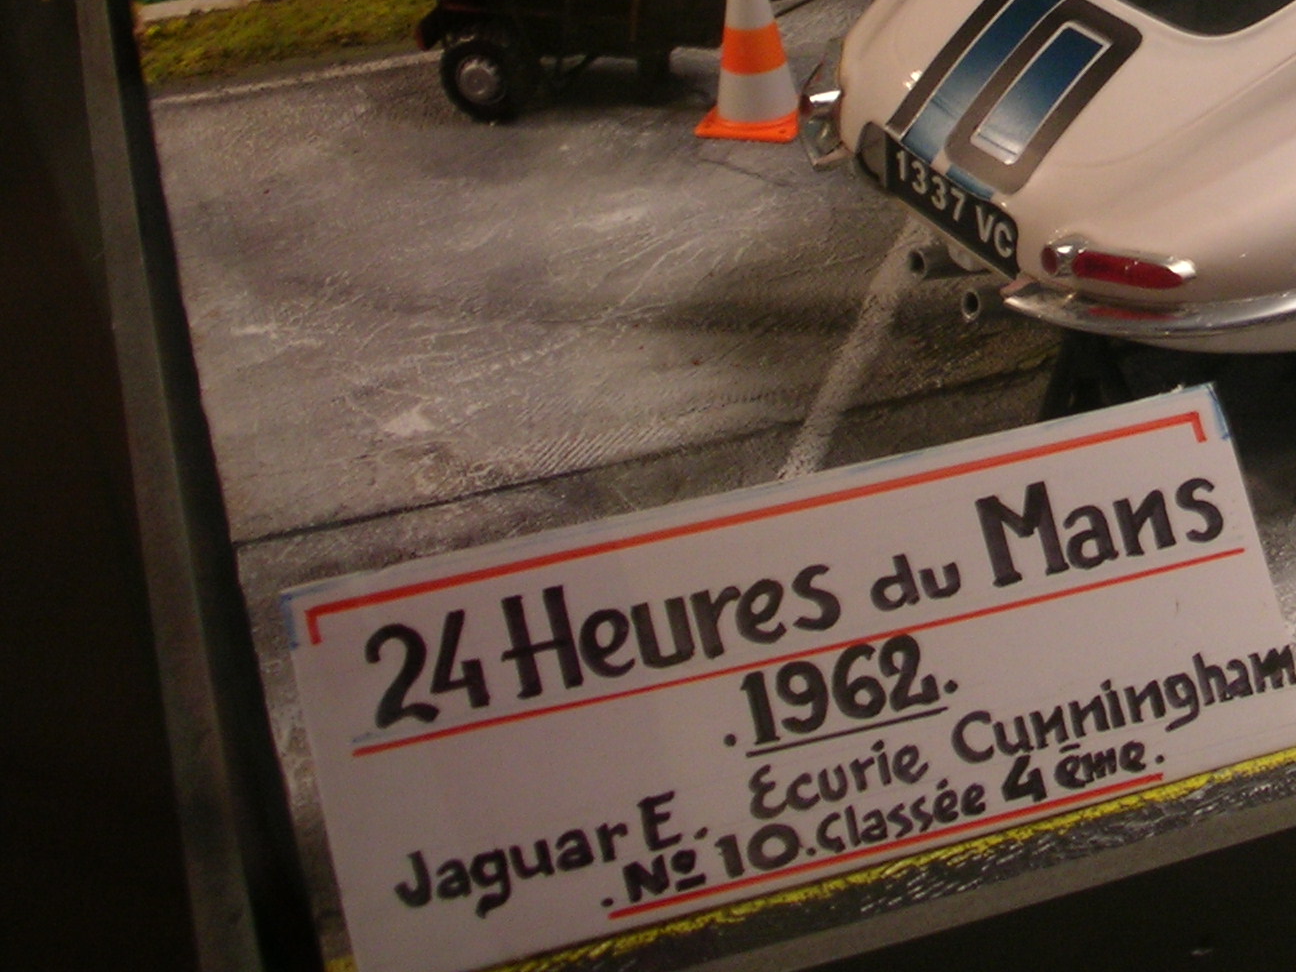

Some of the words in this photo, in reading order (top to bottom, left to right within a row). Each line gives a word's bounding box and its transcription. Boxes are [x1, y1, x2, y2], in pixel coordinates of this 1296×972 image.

[896, 150, 966, 222] 1337
[975, 205, 1013, 259] VC
[364, 609, 491, 729] 24
[501, 563, 842, 700] Heures
[869, 554, 962, 612] du
[975, 477, 1225, 588] Mans
[394, 820, 629, 920] Jaguar
[748, 740, 930, 820] Ecurie
[1000, 754, 1050, 803] 4
